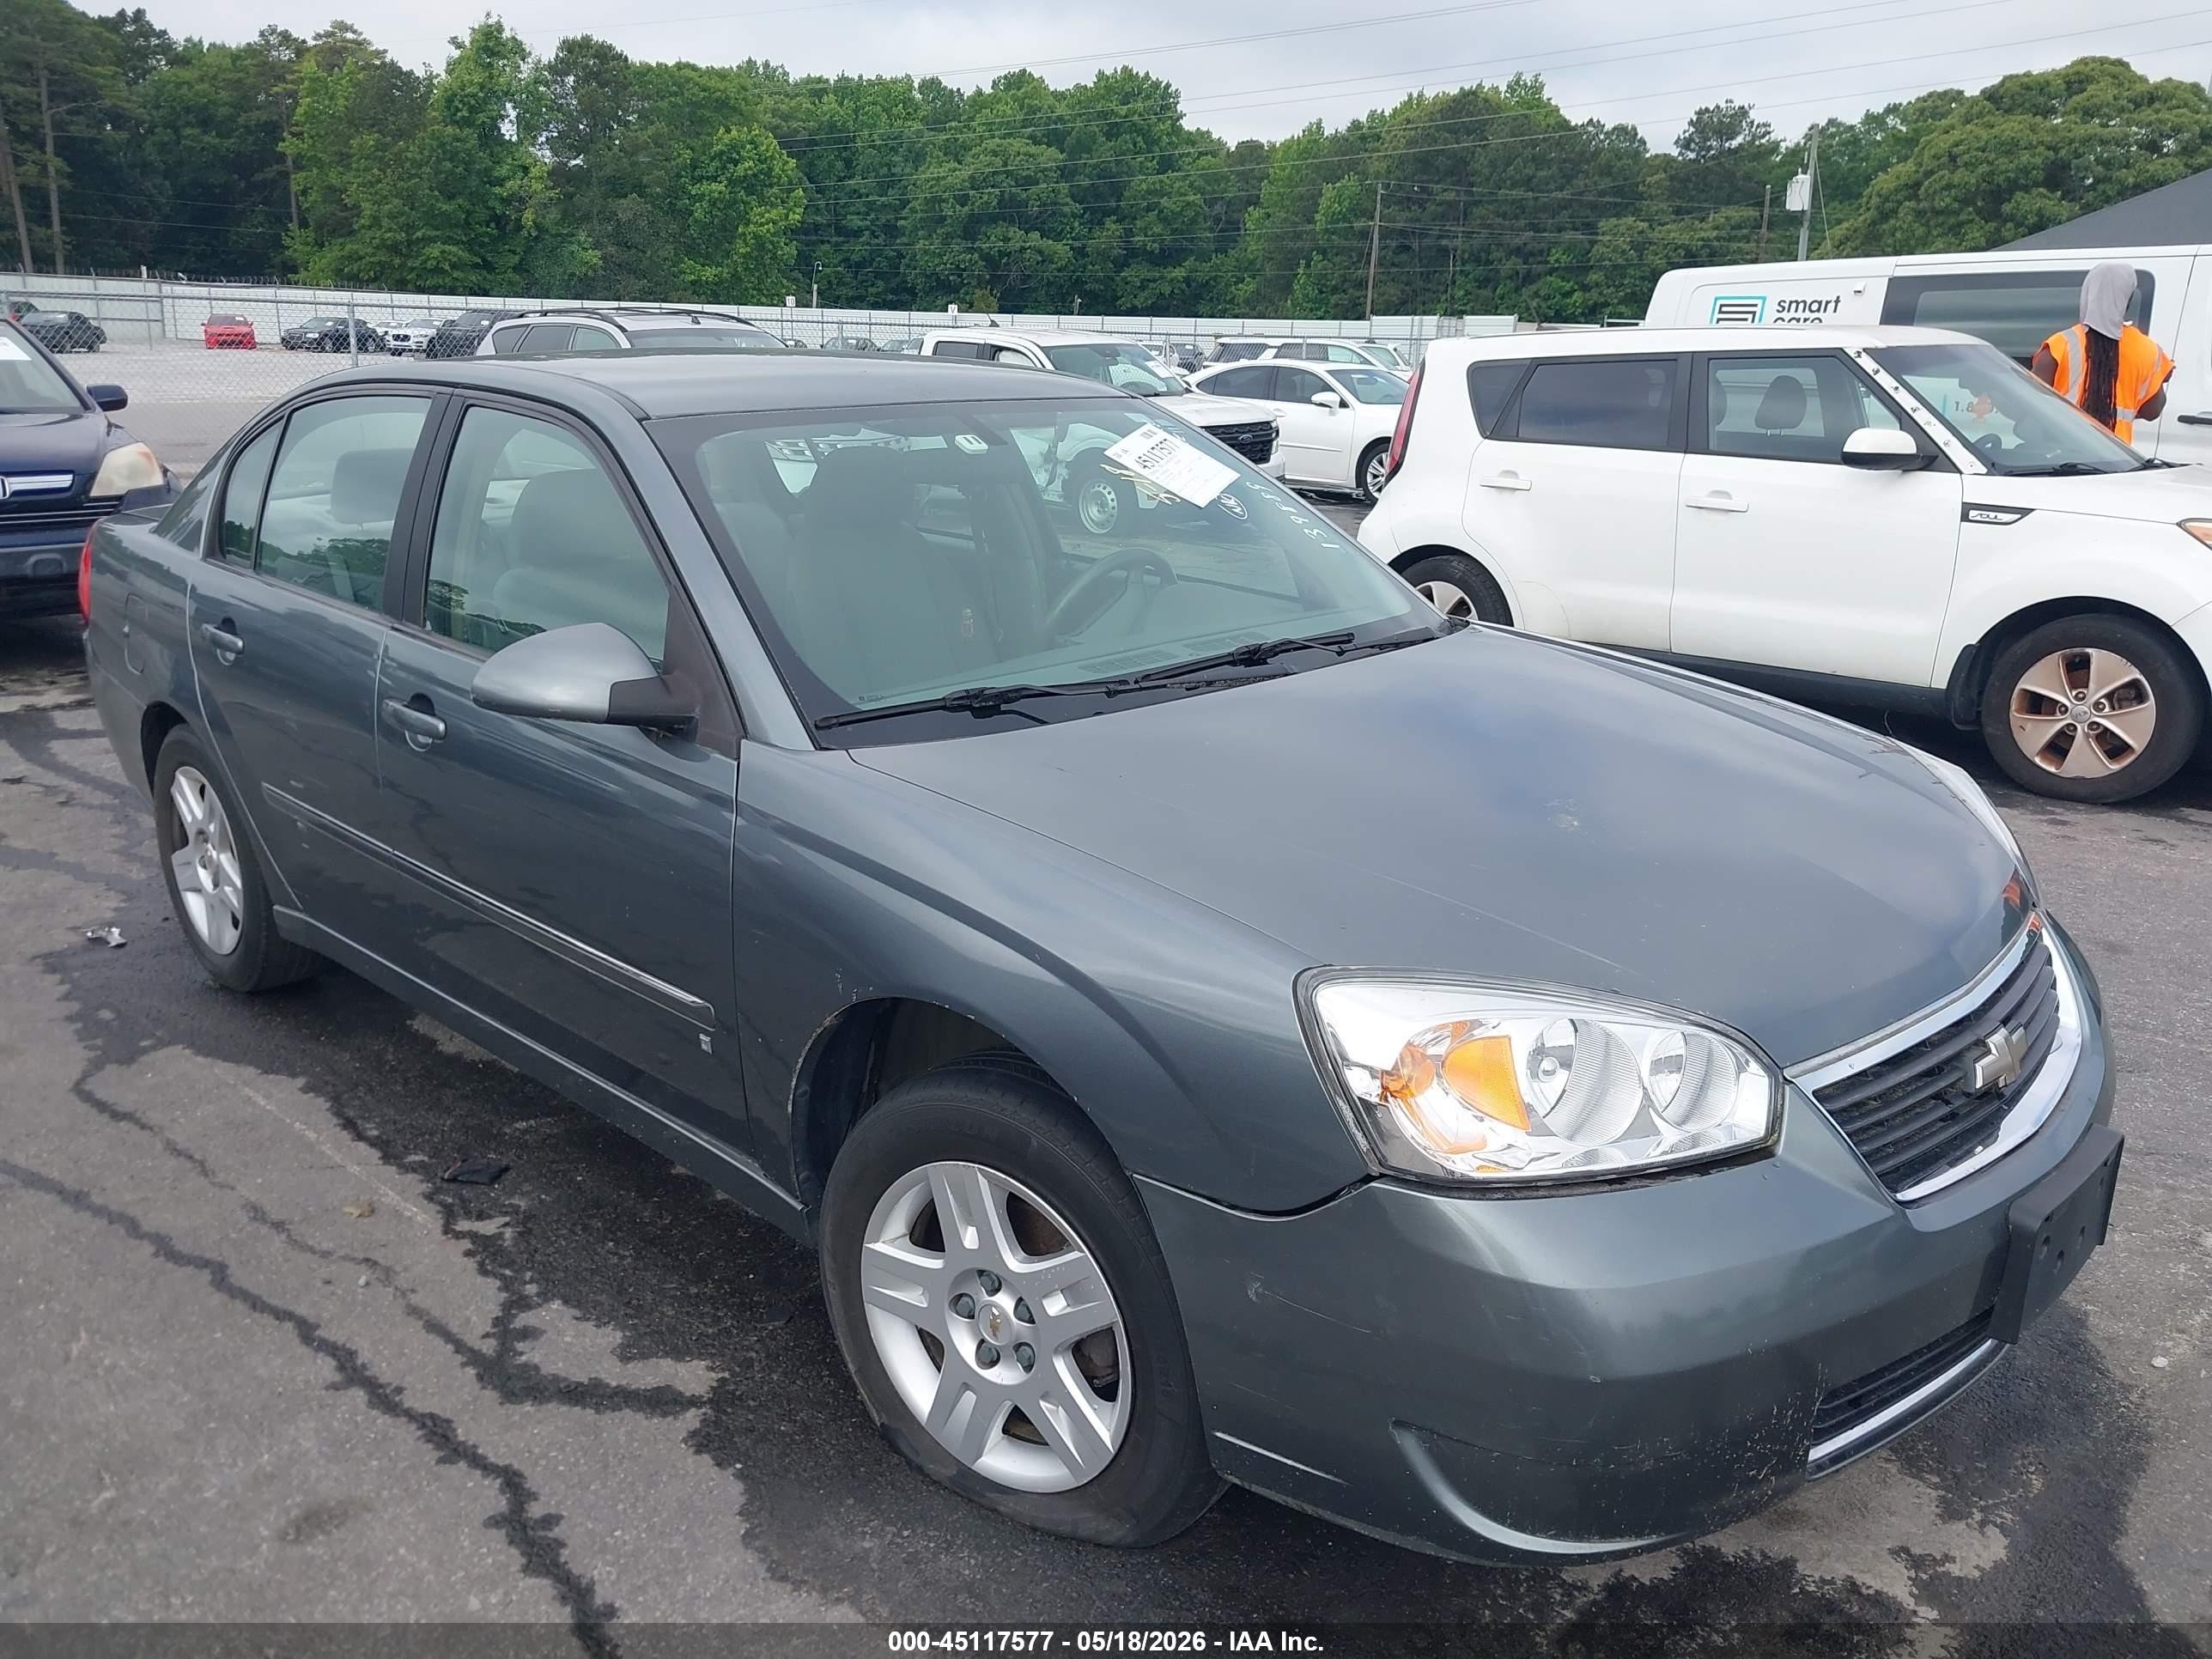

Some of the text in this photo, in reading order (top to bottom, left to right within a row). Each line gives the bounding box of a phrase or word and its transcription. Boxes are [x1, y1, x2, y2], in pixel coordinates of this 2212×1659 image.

[787, 297, 795, 306] 10
[1776, 295, 1841, 314] smart
[950, 306, 957, 314] V
[1133, 438, 1181, 471] 45117577
